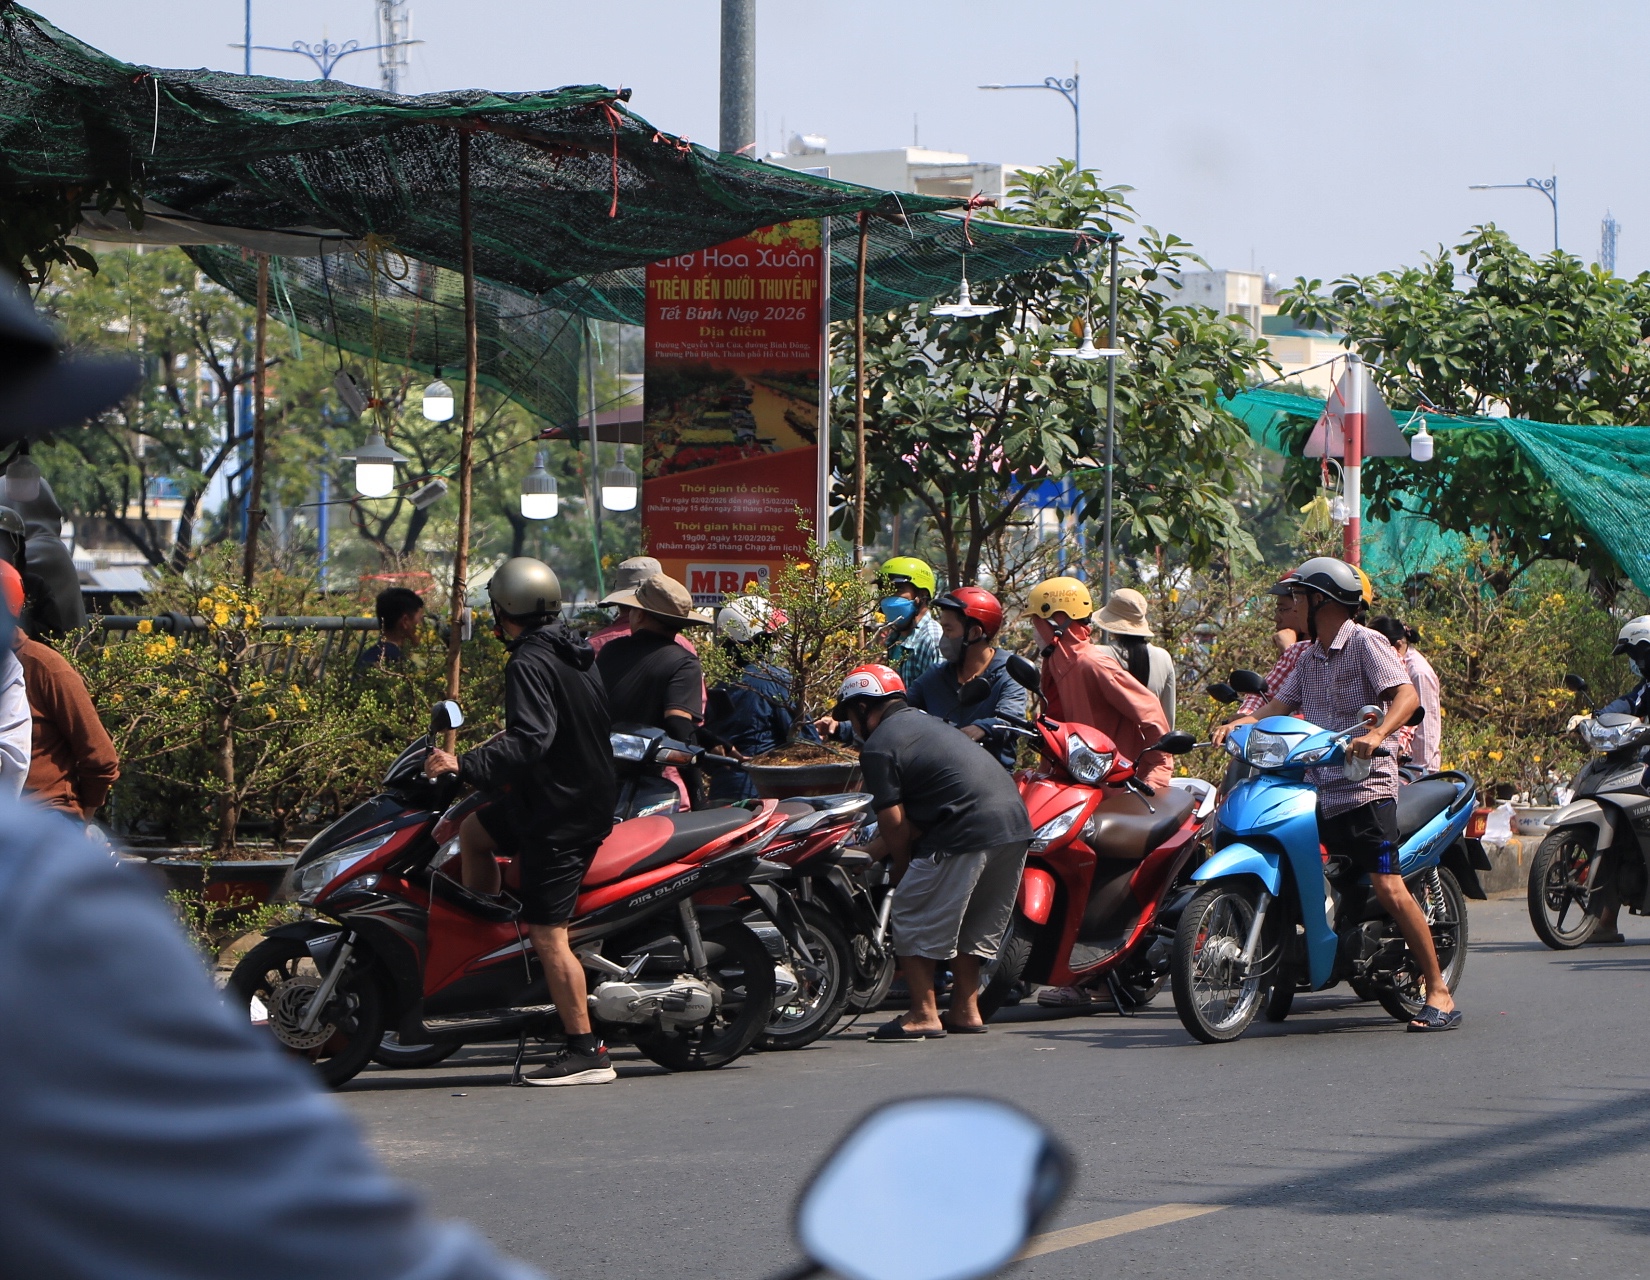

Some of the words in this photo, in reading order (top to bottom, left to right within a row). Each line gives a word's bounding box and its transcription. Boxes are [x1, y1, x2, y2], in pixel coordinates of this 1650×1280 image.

[703, 248, 749, 268] Hoa
[756, 249, 815, 268] Xuân
[649, 274, 690, 300] "TRÊN
[693, 272, 720, 300] BẾN
[724, 274, 755, 300] DƯỚI
[759, 271, 818, 300] THUYỀN"
[660, 305, 682, 320] Tết
[686, 306, 722, 320] Bính
[726, 306, 760, 323] Ngọ
[763, 306, 807, 320] 2026
[699, 326, 725, 339] Địa
[729, 323, 767, 337] điểm
[709, 341, 725, 350] Văn
[680, 484, 706, 494] Thời
[709, 485, 733, 495] gian
[736, 484, 748, 494] tổ
[751, 485, 780, 494] chức
[690, 504, 699, 512] 15
[674, 521, 701, 531] Thời
[703, 522, 729, 533] gian
[732, 522, 757, 532] khai
[760, 524, 785, 534] mạc
[710, 534, 731, 543] ngày
[733, 534, 777, 543] 12/02/2026
[656, 540, 683, 551] (Nhằm
[684, 542, 706, 551] ngày
[707, 542, 717, 550] 25
[719, 542, 743, 552] tháng
[744, 543, 767, 552] Chạp
[628, 892, 653, 908] AIR
[654, 871, 700, 897] BLADE
